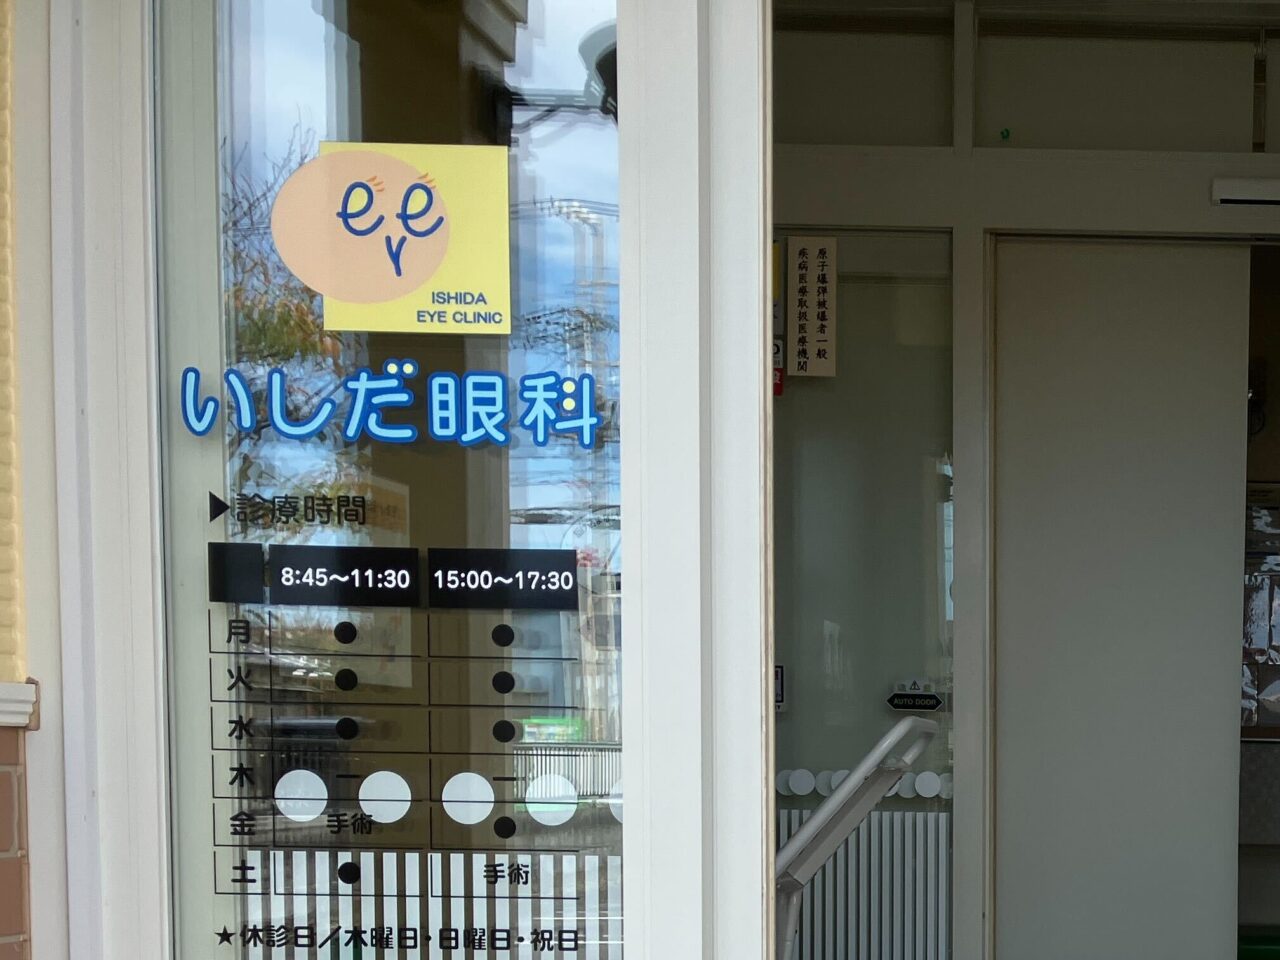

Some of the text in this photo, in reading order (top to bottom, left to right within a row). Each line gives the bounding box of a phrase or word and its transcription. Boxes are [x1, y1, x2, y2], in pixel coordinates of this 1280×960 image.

[431, 291, 488, 305] ISHIDA
[416, 310, 503, 325] EYE CLINIC
[180, 358, 602, 450] いしだ眼科
[236, 494, 366, 526] 診療時間
[226, 619, 251, 645] 月
[226, 666, 254, 692] 火
[227, 715, 254, 741] 水
[228, 762, 255, 788] 木
[229, 811, 373, 836] 金 手術
[231, 859, 530, 886] 土 手術
